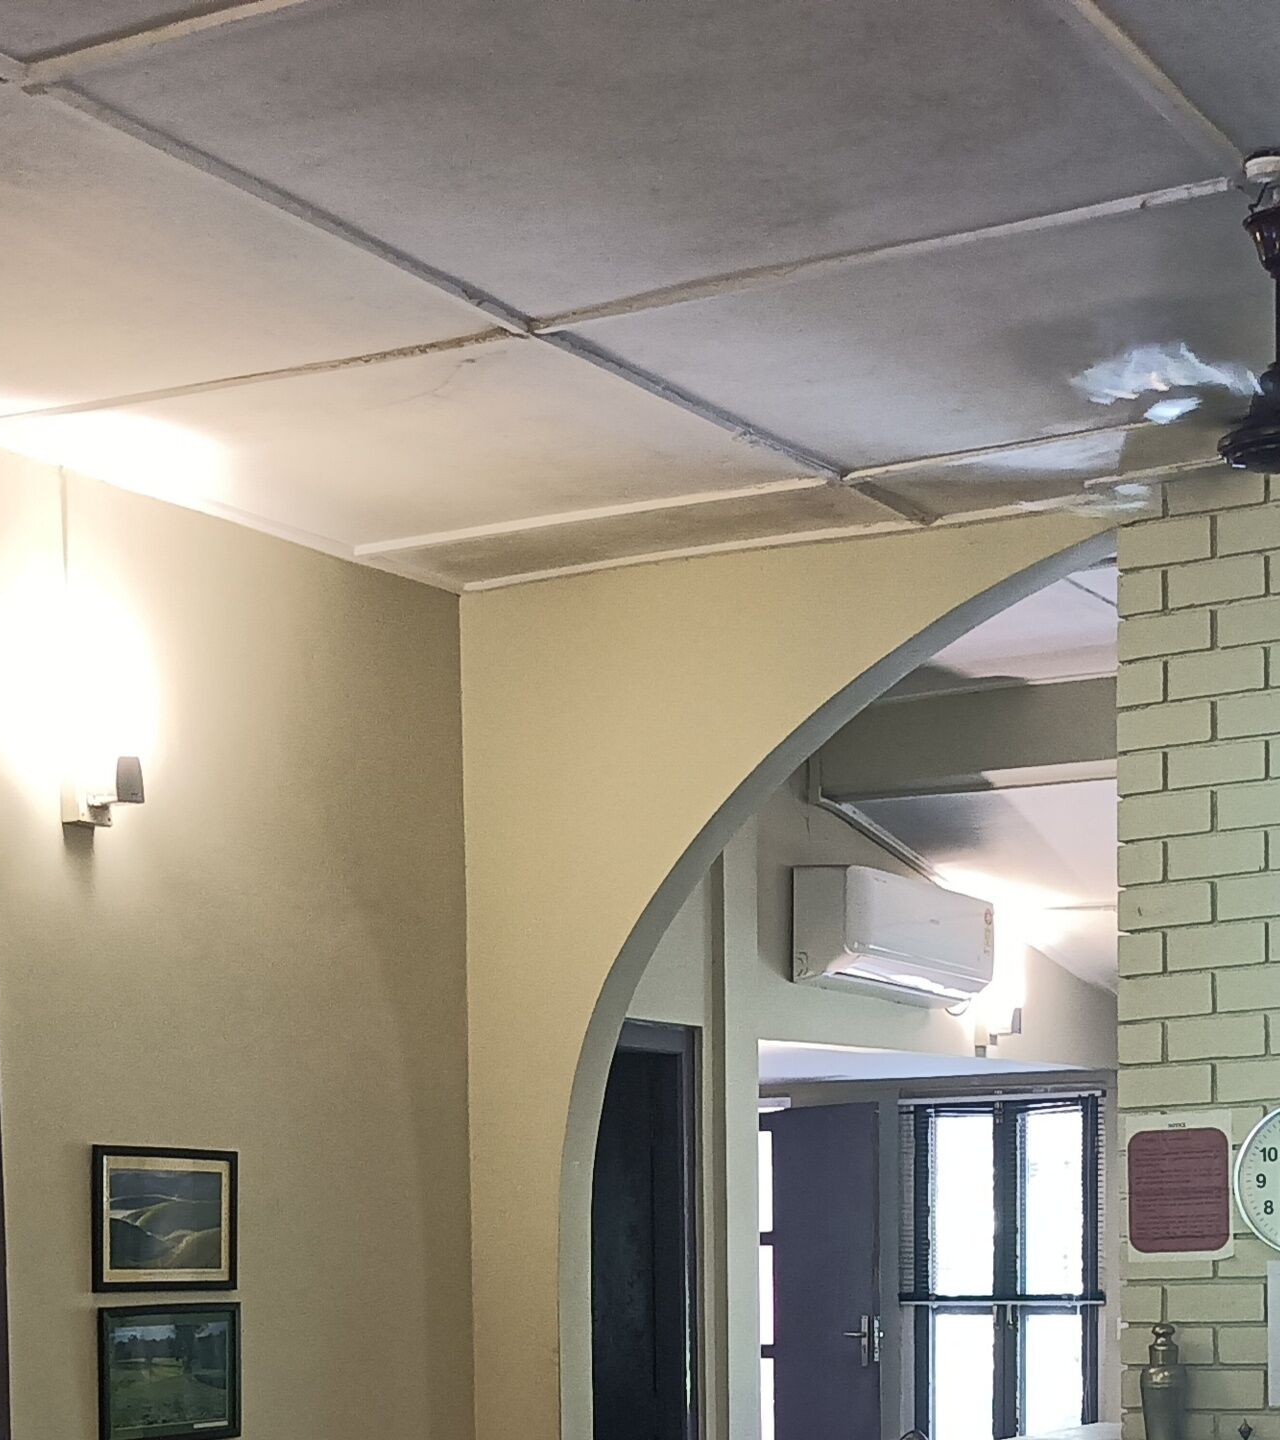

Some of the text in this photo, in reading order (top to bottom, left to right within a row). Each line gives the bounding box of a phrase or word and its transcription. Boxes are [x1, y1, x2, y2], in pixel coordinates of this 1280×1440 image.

[1260, 1147, 1278, 1162] 10
[1256, 1173, 1266, 1188] 9
[1263, 1200, 1274, 1215] 8
